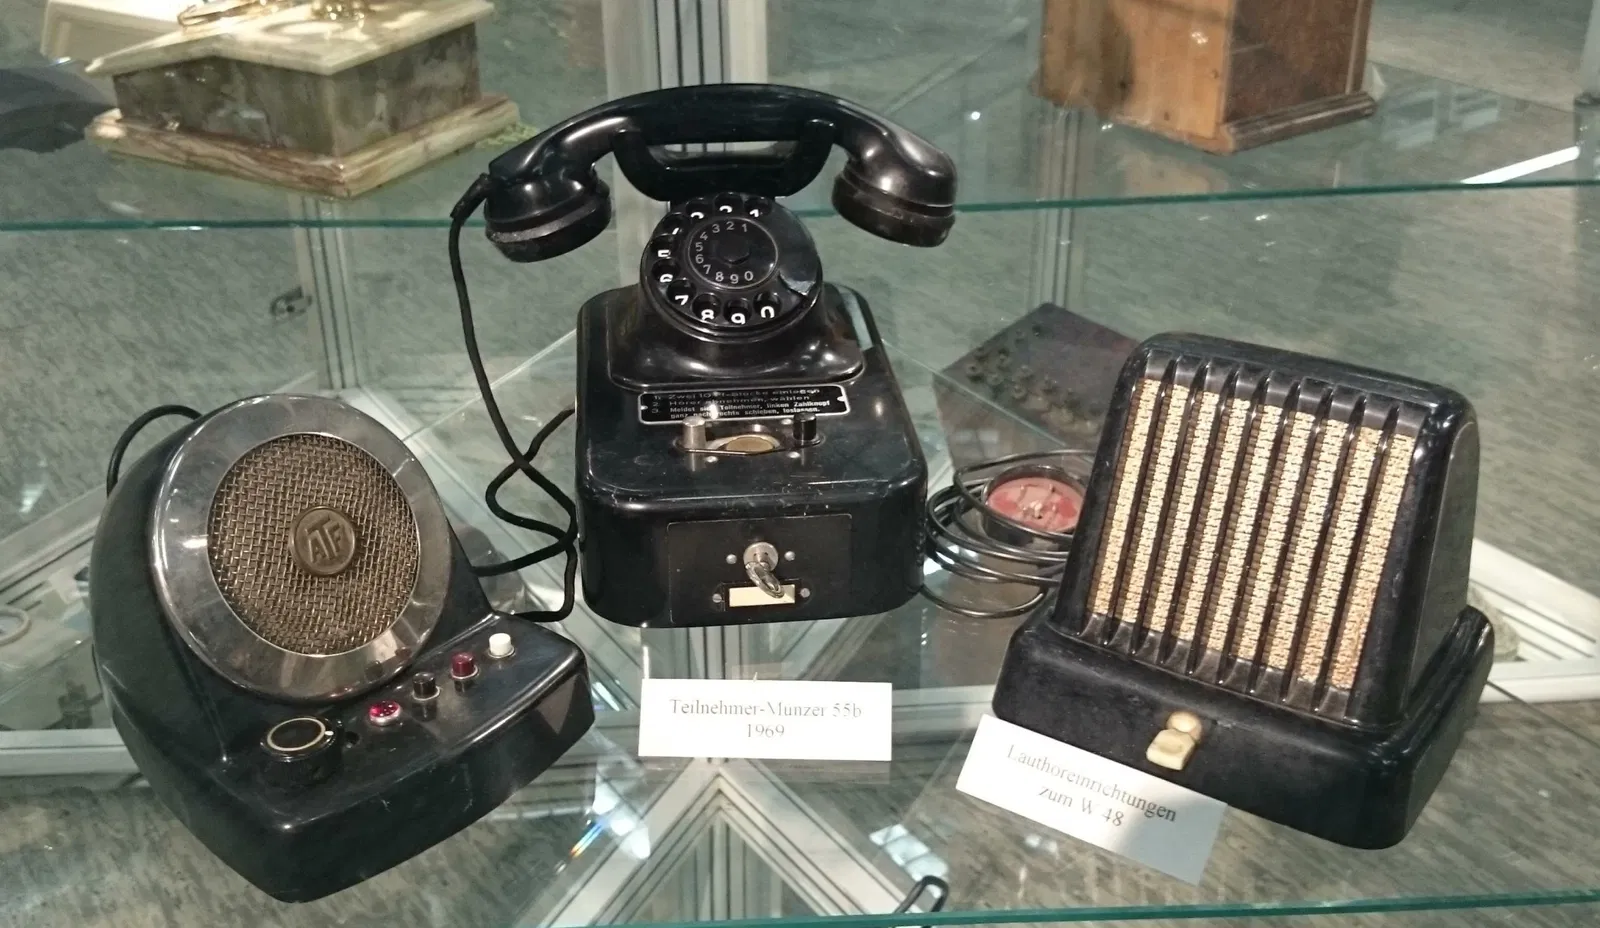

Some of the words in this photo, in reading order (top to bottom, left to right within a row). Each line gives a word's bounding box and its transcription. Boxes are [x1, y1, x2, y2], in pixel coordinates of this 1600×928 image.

[711, 223, 721, 234] 3
[726, 220, 735, 231] 2
[741, 223, 748, 233] 1
[700, 231, 708, 241] 4
[695, 241, 704, 252] 5
[695, 253, 704, 264] 6
[702, 264, 712, 275] 7
[715, 271, 725, 282] 8
[730, 273, 739, 284] 9
[744, 270, 754, 281] 0
[674, 294, 689, 306] 7
[701, 309, 715, 321] 8
[730, 313, 746, 325] 9
[832, 702, 862, 718] 55b
[747, 723, 785, 738] 1969
[1037, 786, 1073, 808] zum
[1081, 796, 1100, 815] W
[1101, 808, 1125, 827] 48
